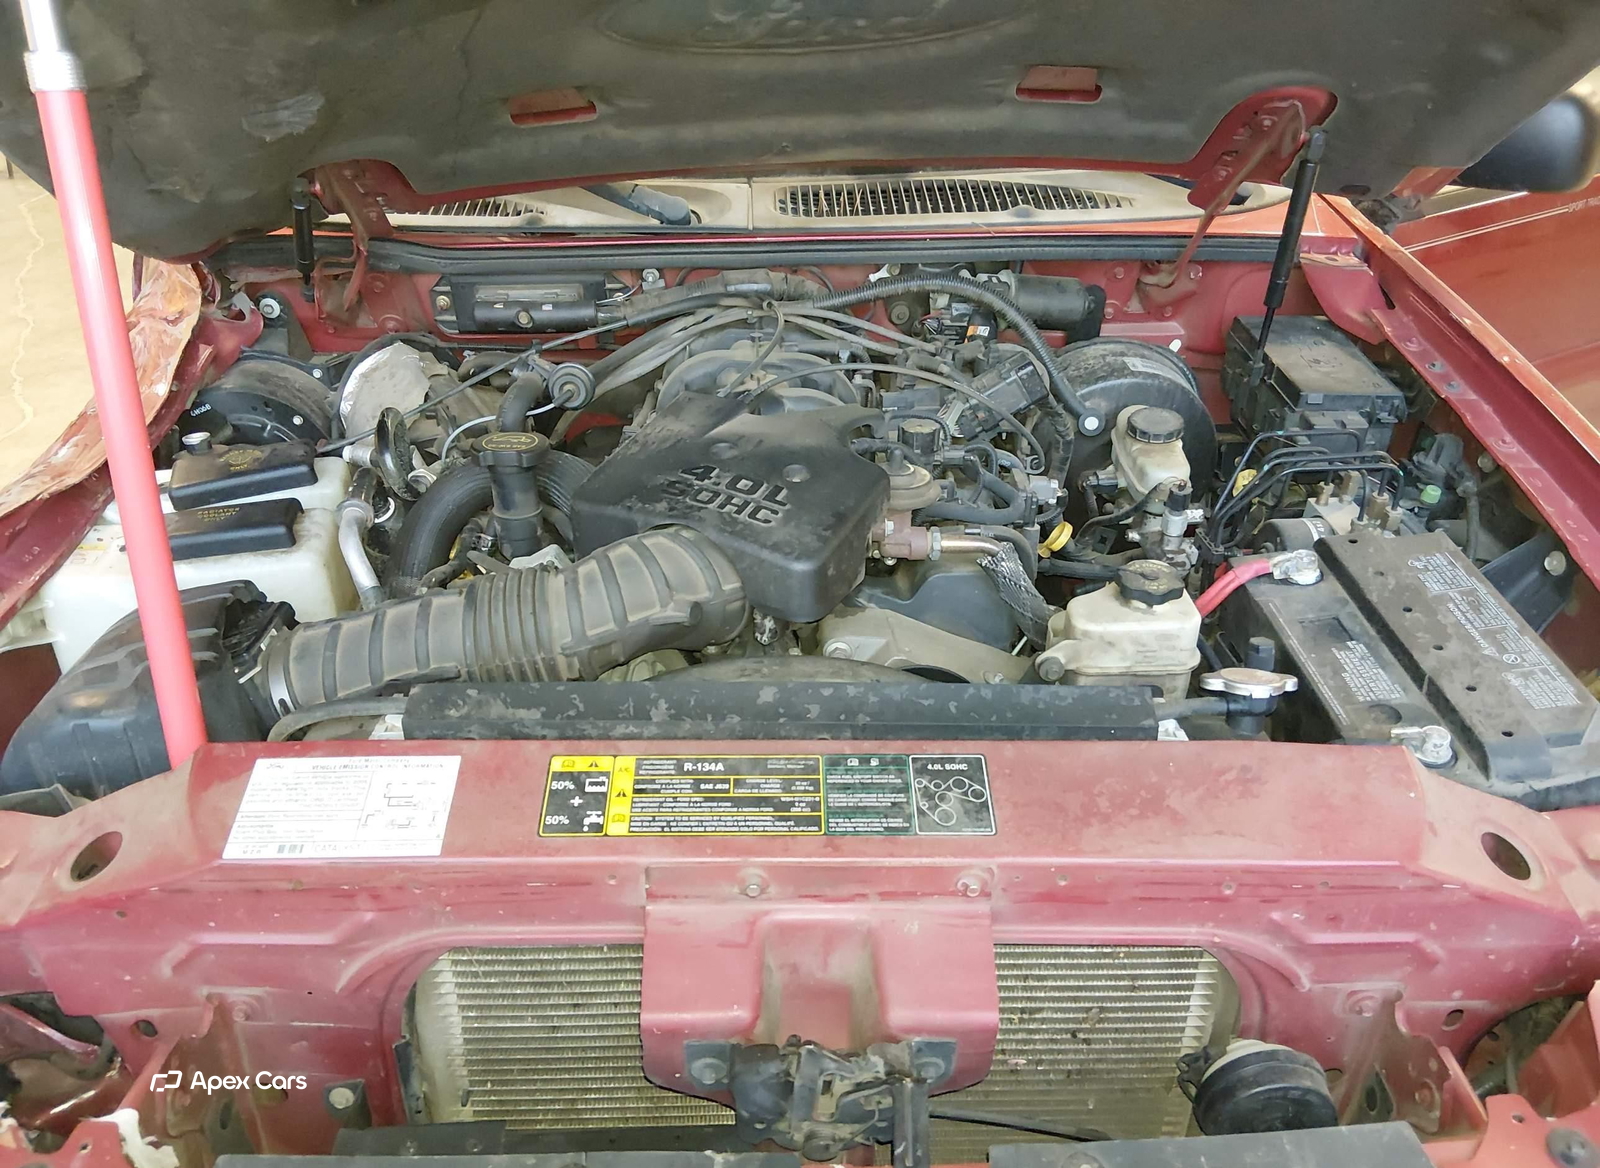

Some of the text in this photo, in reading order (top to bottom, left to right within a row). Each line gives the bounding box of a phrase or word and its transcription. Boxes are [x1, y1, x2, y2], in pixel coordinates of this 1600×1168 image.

[677, 464, 792, 510] 4.0L
[660, 479, 783, 527] SOHC
[683, 762, 725, 772] R-134A
[927, 763, 968, 771] 4.0L SOHC
[551, 781, 575, 790] 50%
[545, 815, 569, 825] 50%
